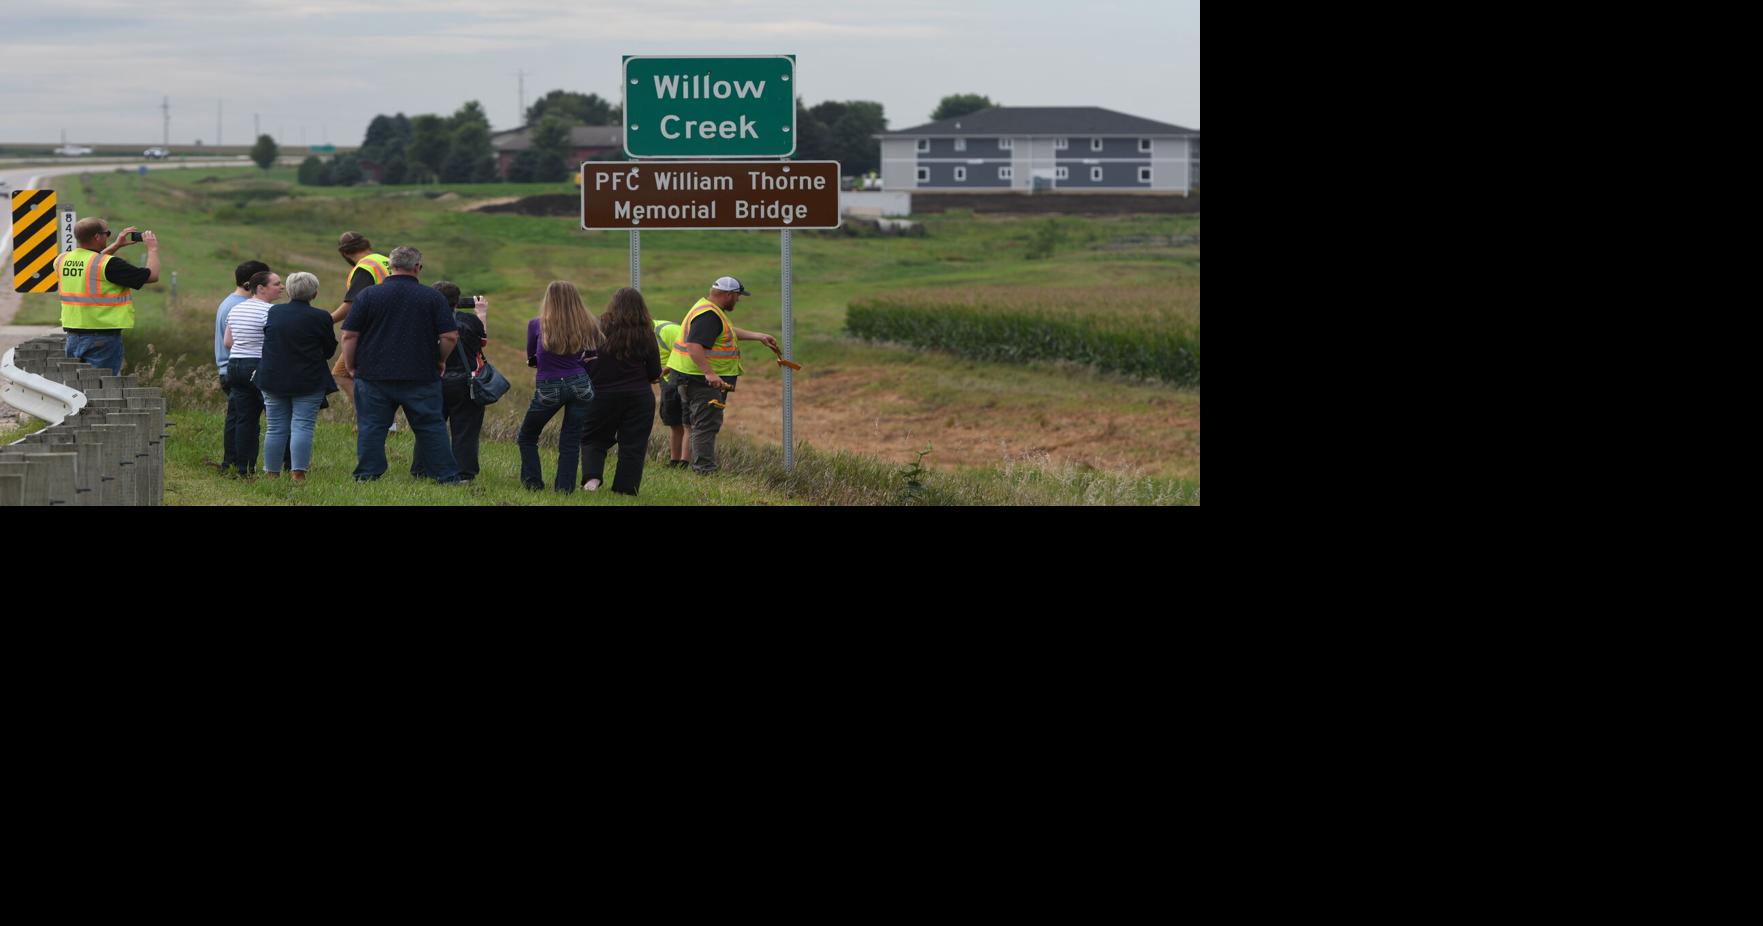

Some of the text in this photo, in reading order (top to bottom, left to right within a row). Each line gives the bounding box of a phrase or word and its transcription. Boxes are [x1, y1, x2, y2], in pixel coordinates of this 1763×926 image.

[654, 75, 766, 99] Willow
[660, 115, 759, 139] Creek
[595, 171, 826, 191] PFC William Thorne
[614, 200, 808, 222] Memorial Bridge
[62, 268, 84, 277] DOT
[64, 260, 84, 268] IOWA
